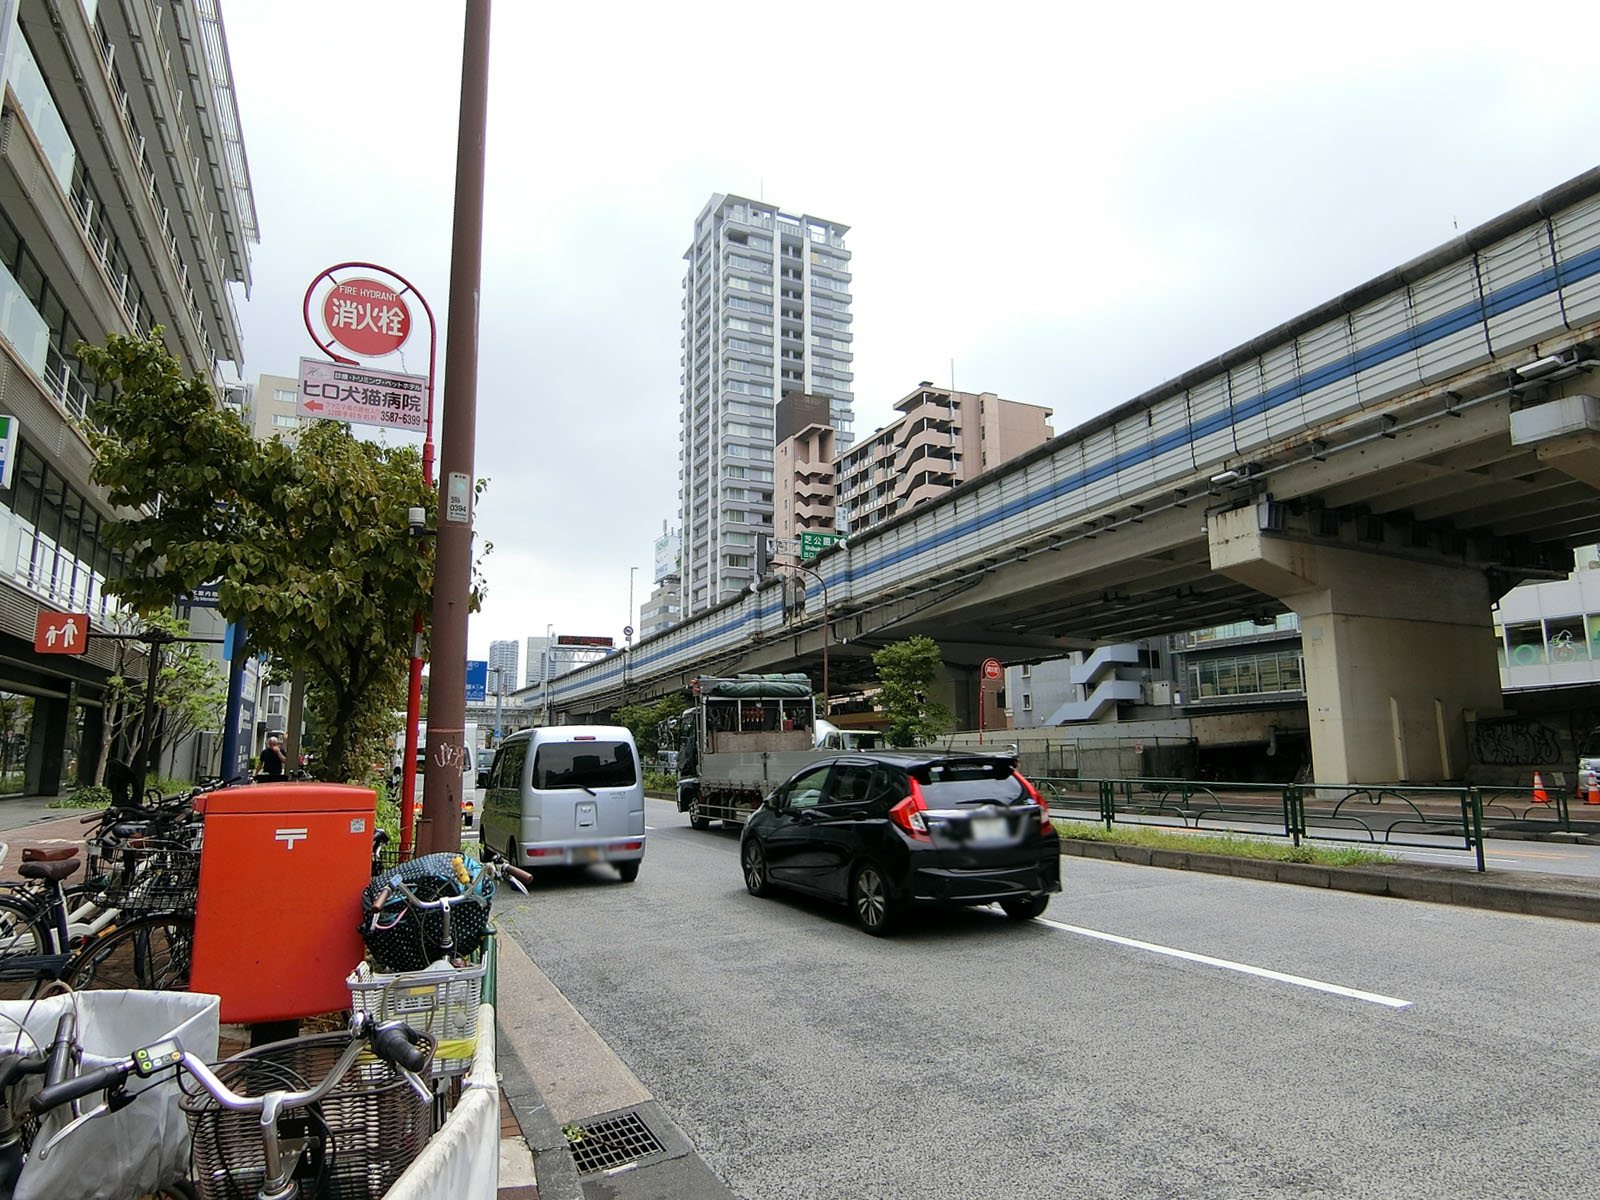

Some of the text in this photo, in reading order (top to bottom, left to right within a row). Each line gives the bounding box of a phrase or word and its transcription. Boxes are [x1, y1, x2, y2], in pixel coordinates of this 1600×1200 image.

[339, 285, 397, 302] FIRE HYDRANT
[332, 298, 405, 336] 消火栓
[303, 380, 421, 412] ヒロ犬猫病院
[380, 410, 421, 426] 3587-6399
[804, 536, 830, 546] 芝公園
